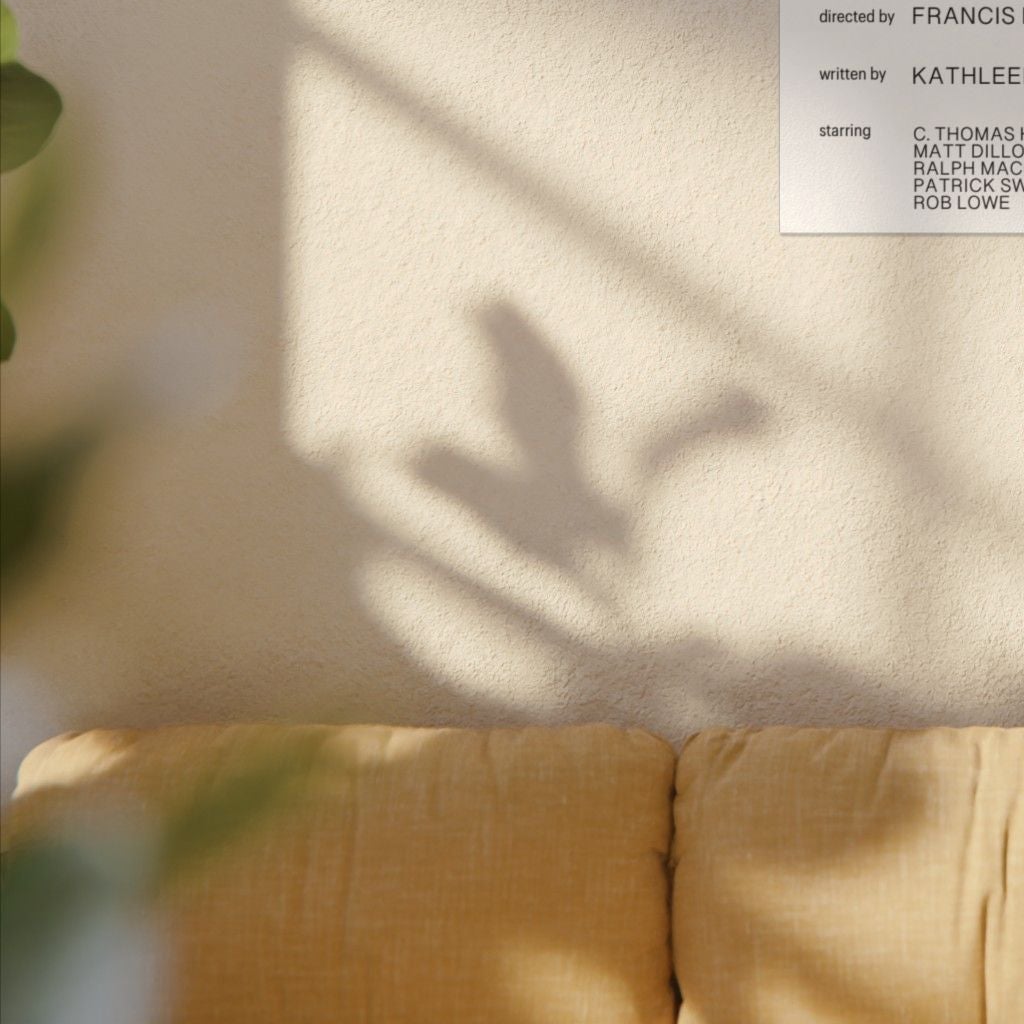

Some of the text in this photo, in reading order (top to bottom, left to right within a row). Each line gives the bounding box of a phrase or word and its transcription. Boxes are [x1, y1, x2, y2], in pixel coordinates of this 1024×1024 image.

[820, 9, 895, 25] directed by
[913, 7, 1014, 25] FRANCIS
[819, 67, 886, 83] written by
[820, 124, 871, 140] starring
[914, 127, 930, 141] C.
[935, 126, 1014, 141] THOMAS
[914, 144, 966, 158] MATT
[914, 161, 974, 175] RALPH
[914, 178, 994, 192] PATRICK
[914, 195, 1010, 210] ROB LOWE
